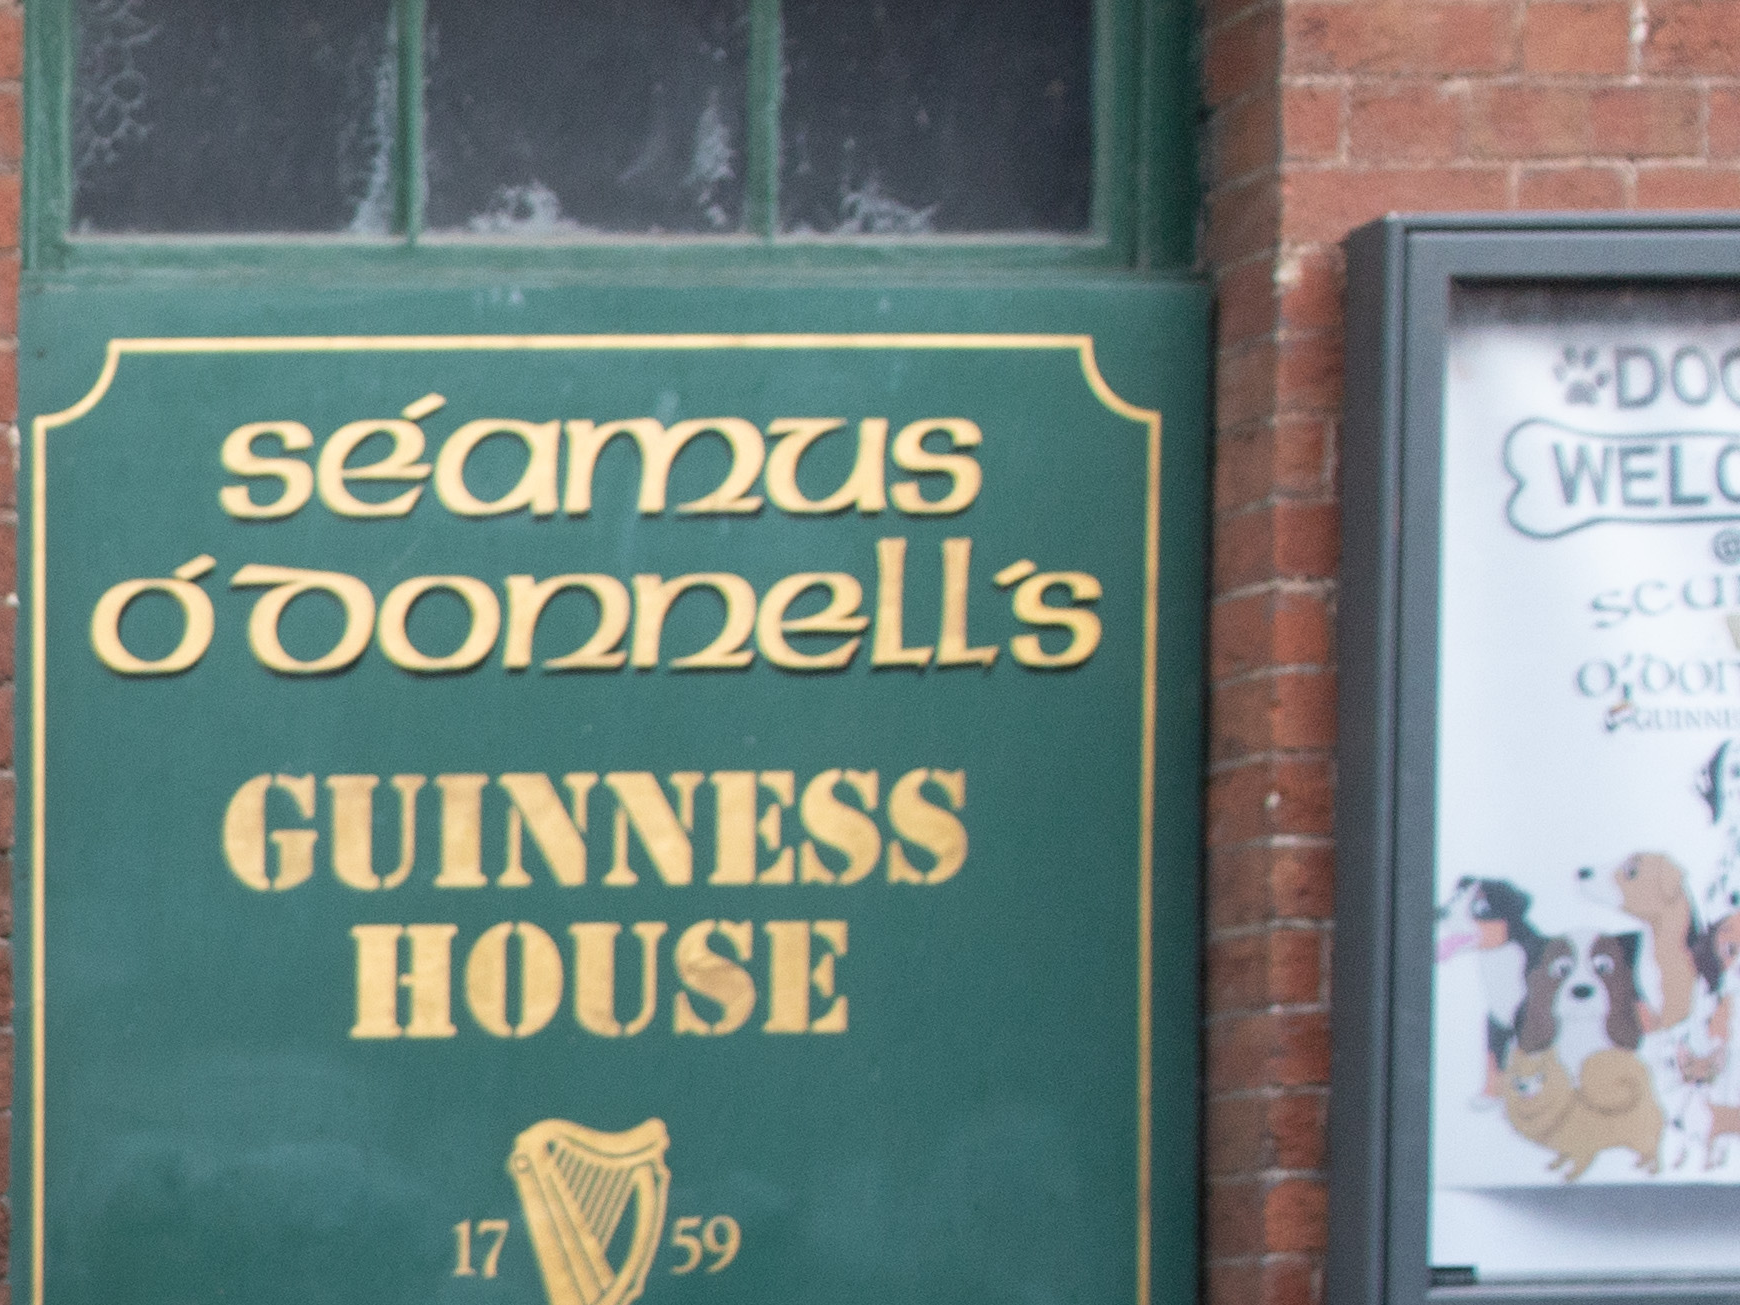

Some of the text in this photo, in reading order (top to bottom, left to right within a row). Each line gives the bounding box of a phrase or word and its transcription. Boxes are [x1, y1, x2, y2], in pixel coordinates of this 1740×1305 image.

[220, 767, 970, 891] GUINNESS
[348, 919, 850, 1039] HOUSE
[451, 1213, 742, 1280] 17 59
